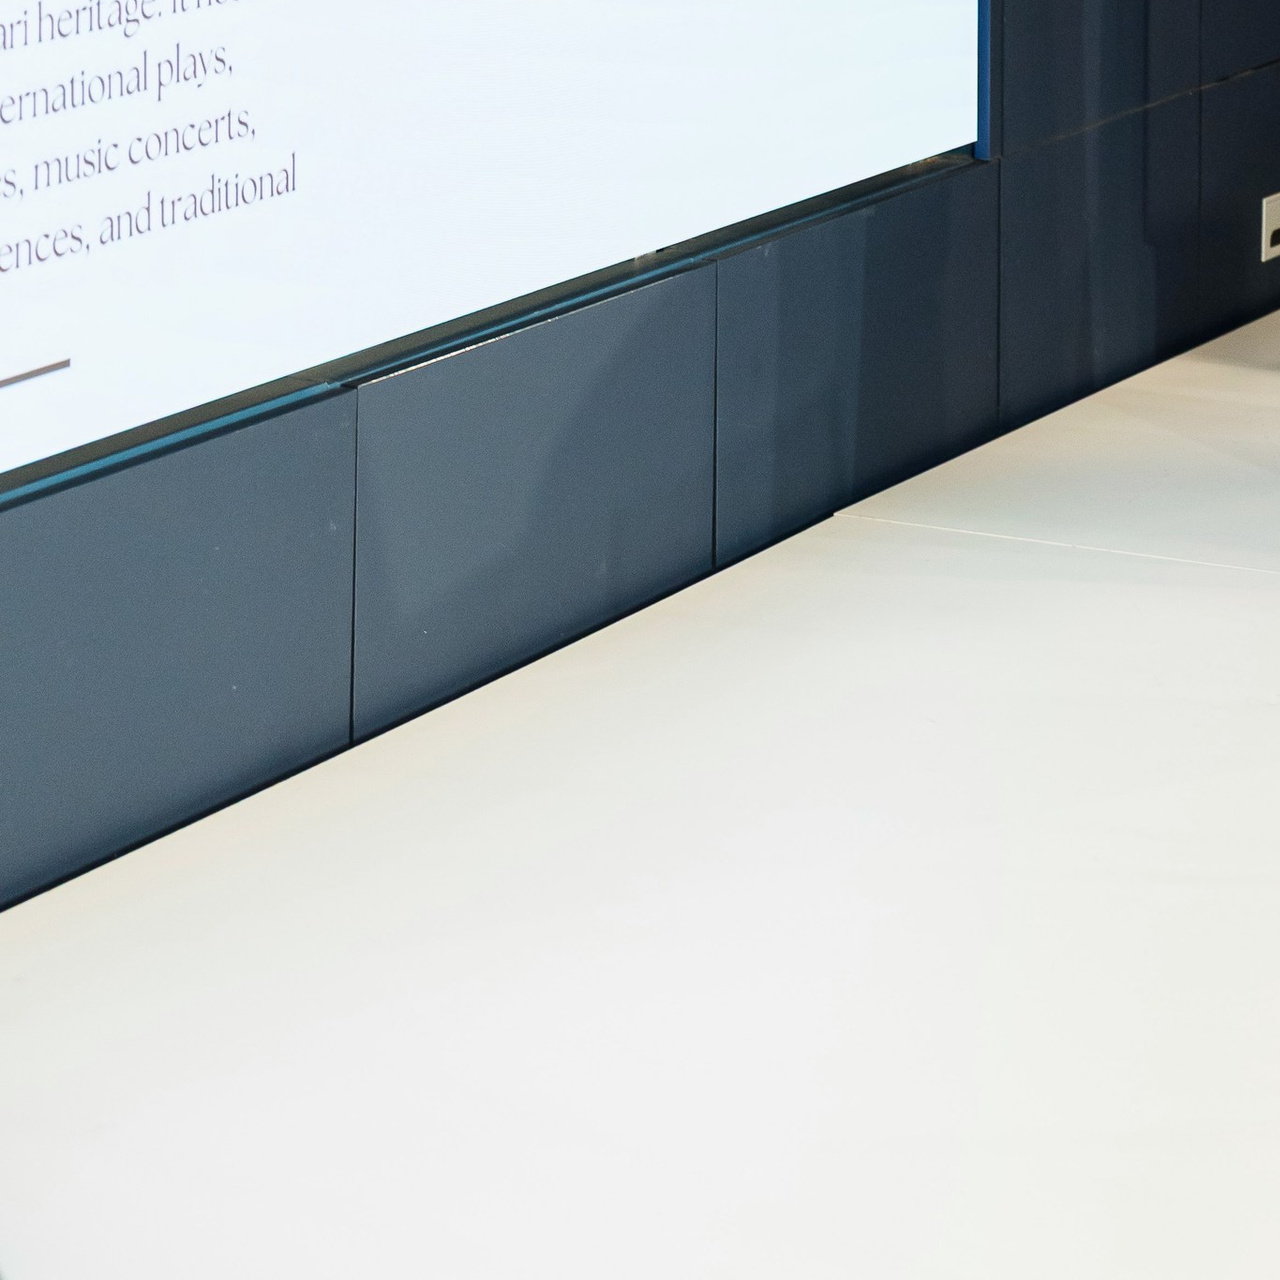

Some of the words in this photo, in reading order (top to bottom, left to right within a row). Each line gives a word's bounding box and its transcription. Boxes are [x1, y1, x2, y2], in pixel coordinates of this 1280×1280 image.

[0, 49, 148, 125] ernational
[156, 41, 233, 103] plays,
[33, 138, 119, 191] music
[127, 108, 256, 166] concerts,
[0, 224, 90, 274] ences,
[99, 190, 152, 246] and
[157, 149, 296, 229] traditional
